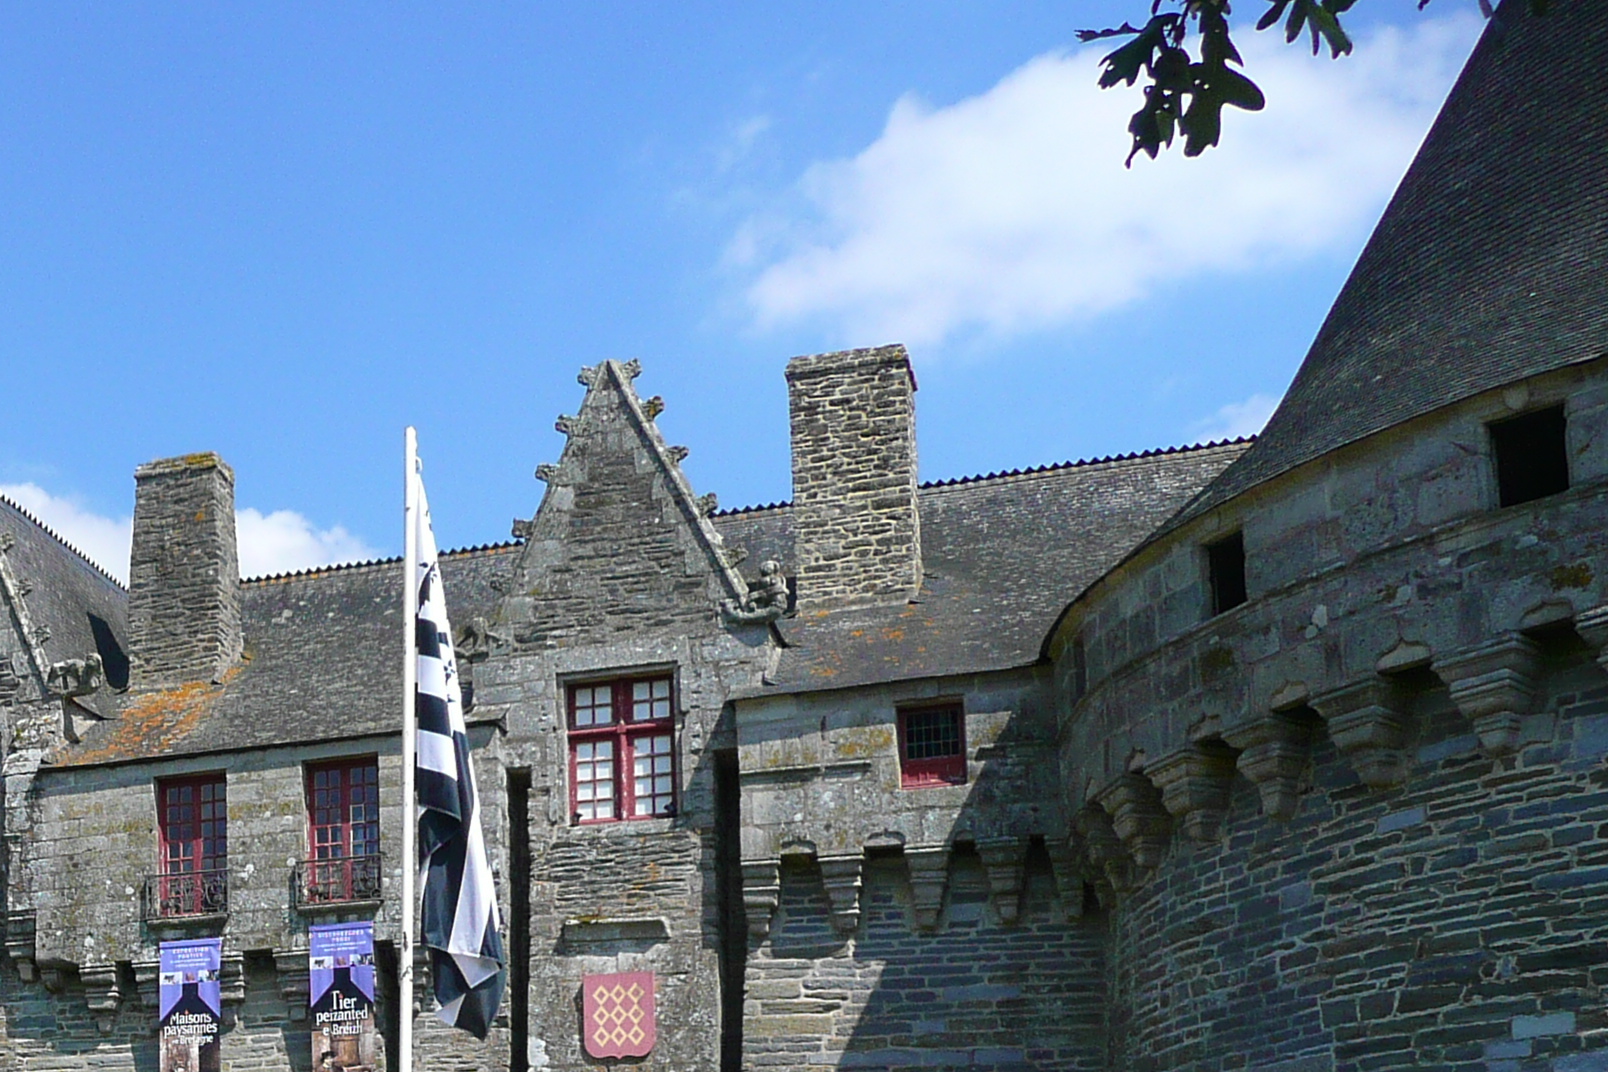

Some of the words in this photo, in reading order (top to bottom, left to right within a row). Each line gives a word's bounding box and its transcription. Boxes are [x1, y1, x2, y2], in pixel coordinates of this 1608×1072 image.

[332, 990, 357, 1010] Tier
[170, 1010, 212, 1025] Maisons
[164, 1022, 218, 1039] paysannes
